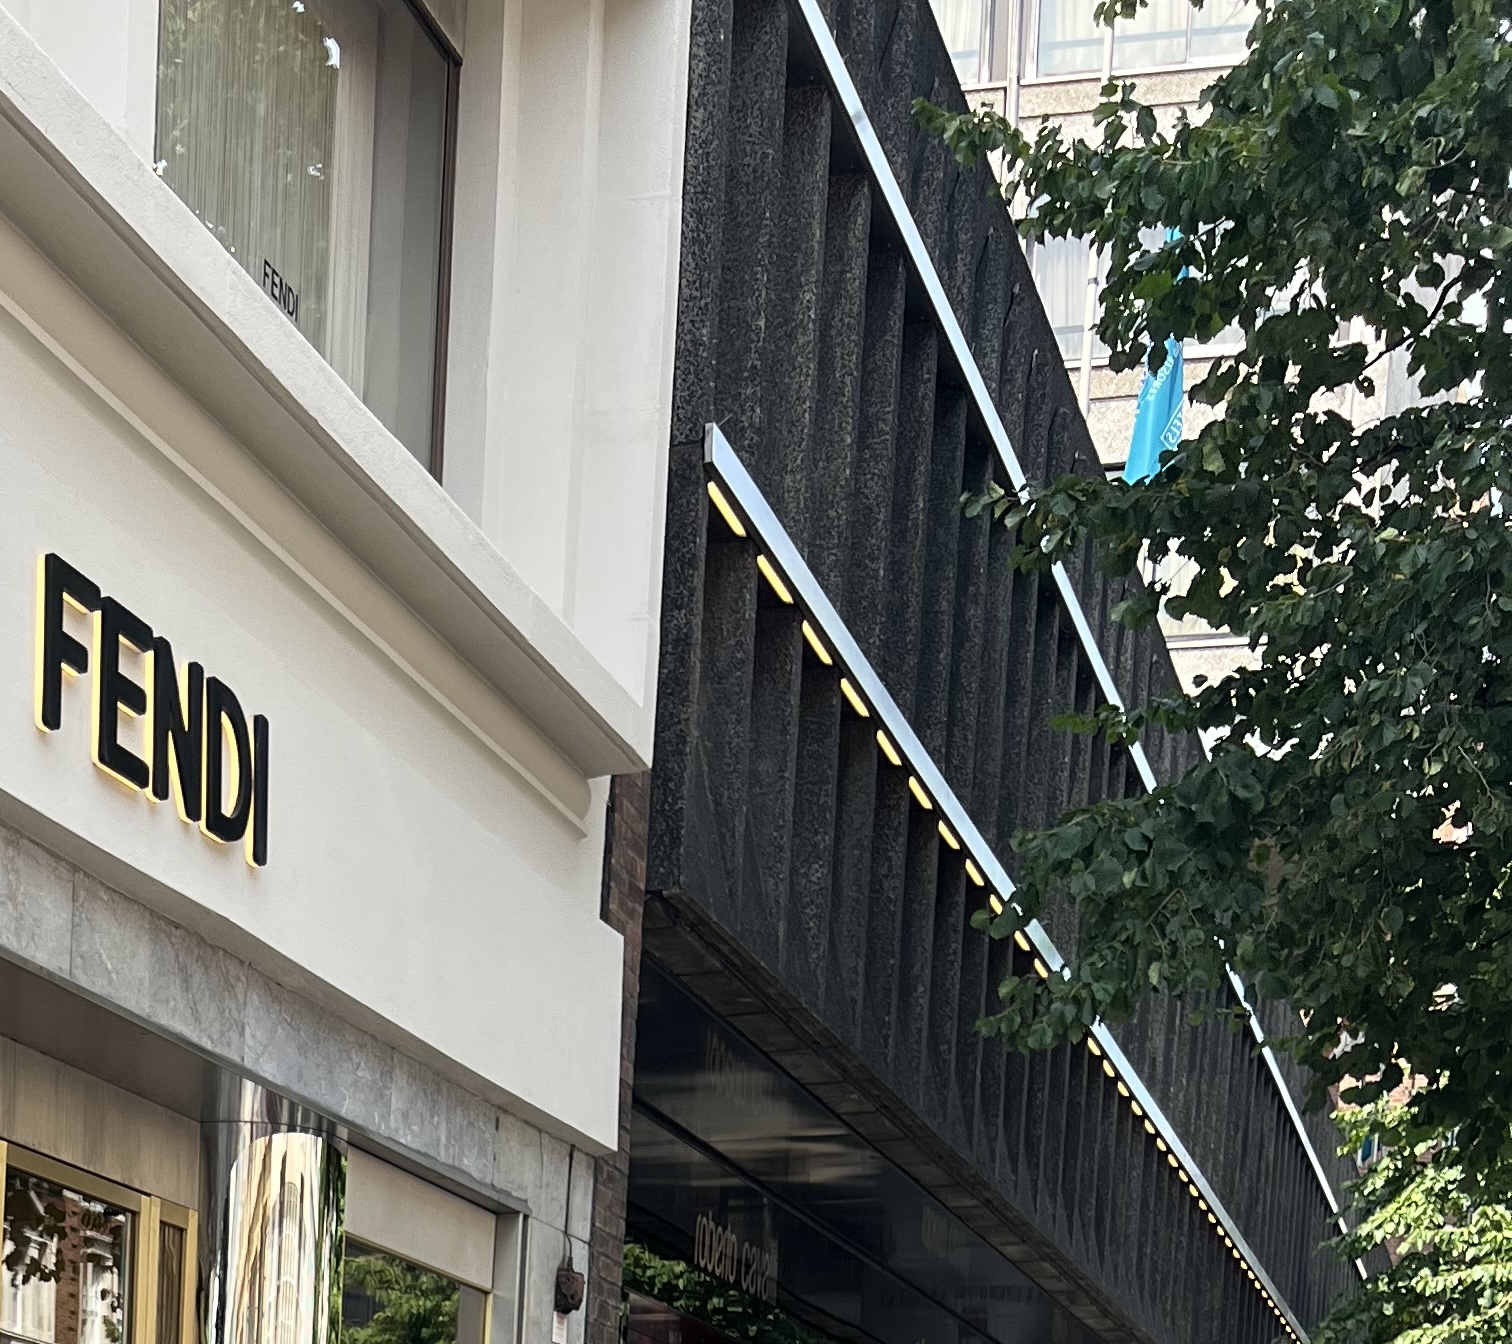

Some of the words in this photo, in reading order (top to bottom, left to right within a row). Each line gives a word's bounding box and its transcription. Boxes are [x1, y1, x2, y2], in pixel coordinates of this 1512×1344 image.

[262, 258, 299, 324] FENDI
[38, 552, 270, 867] FENDI
[694, 1209, 738, 1284] roberto
